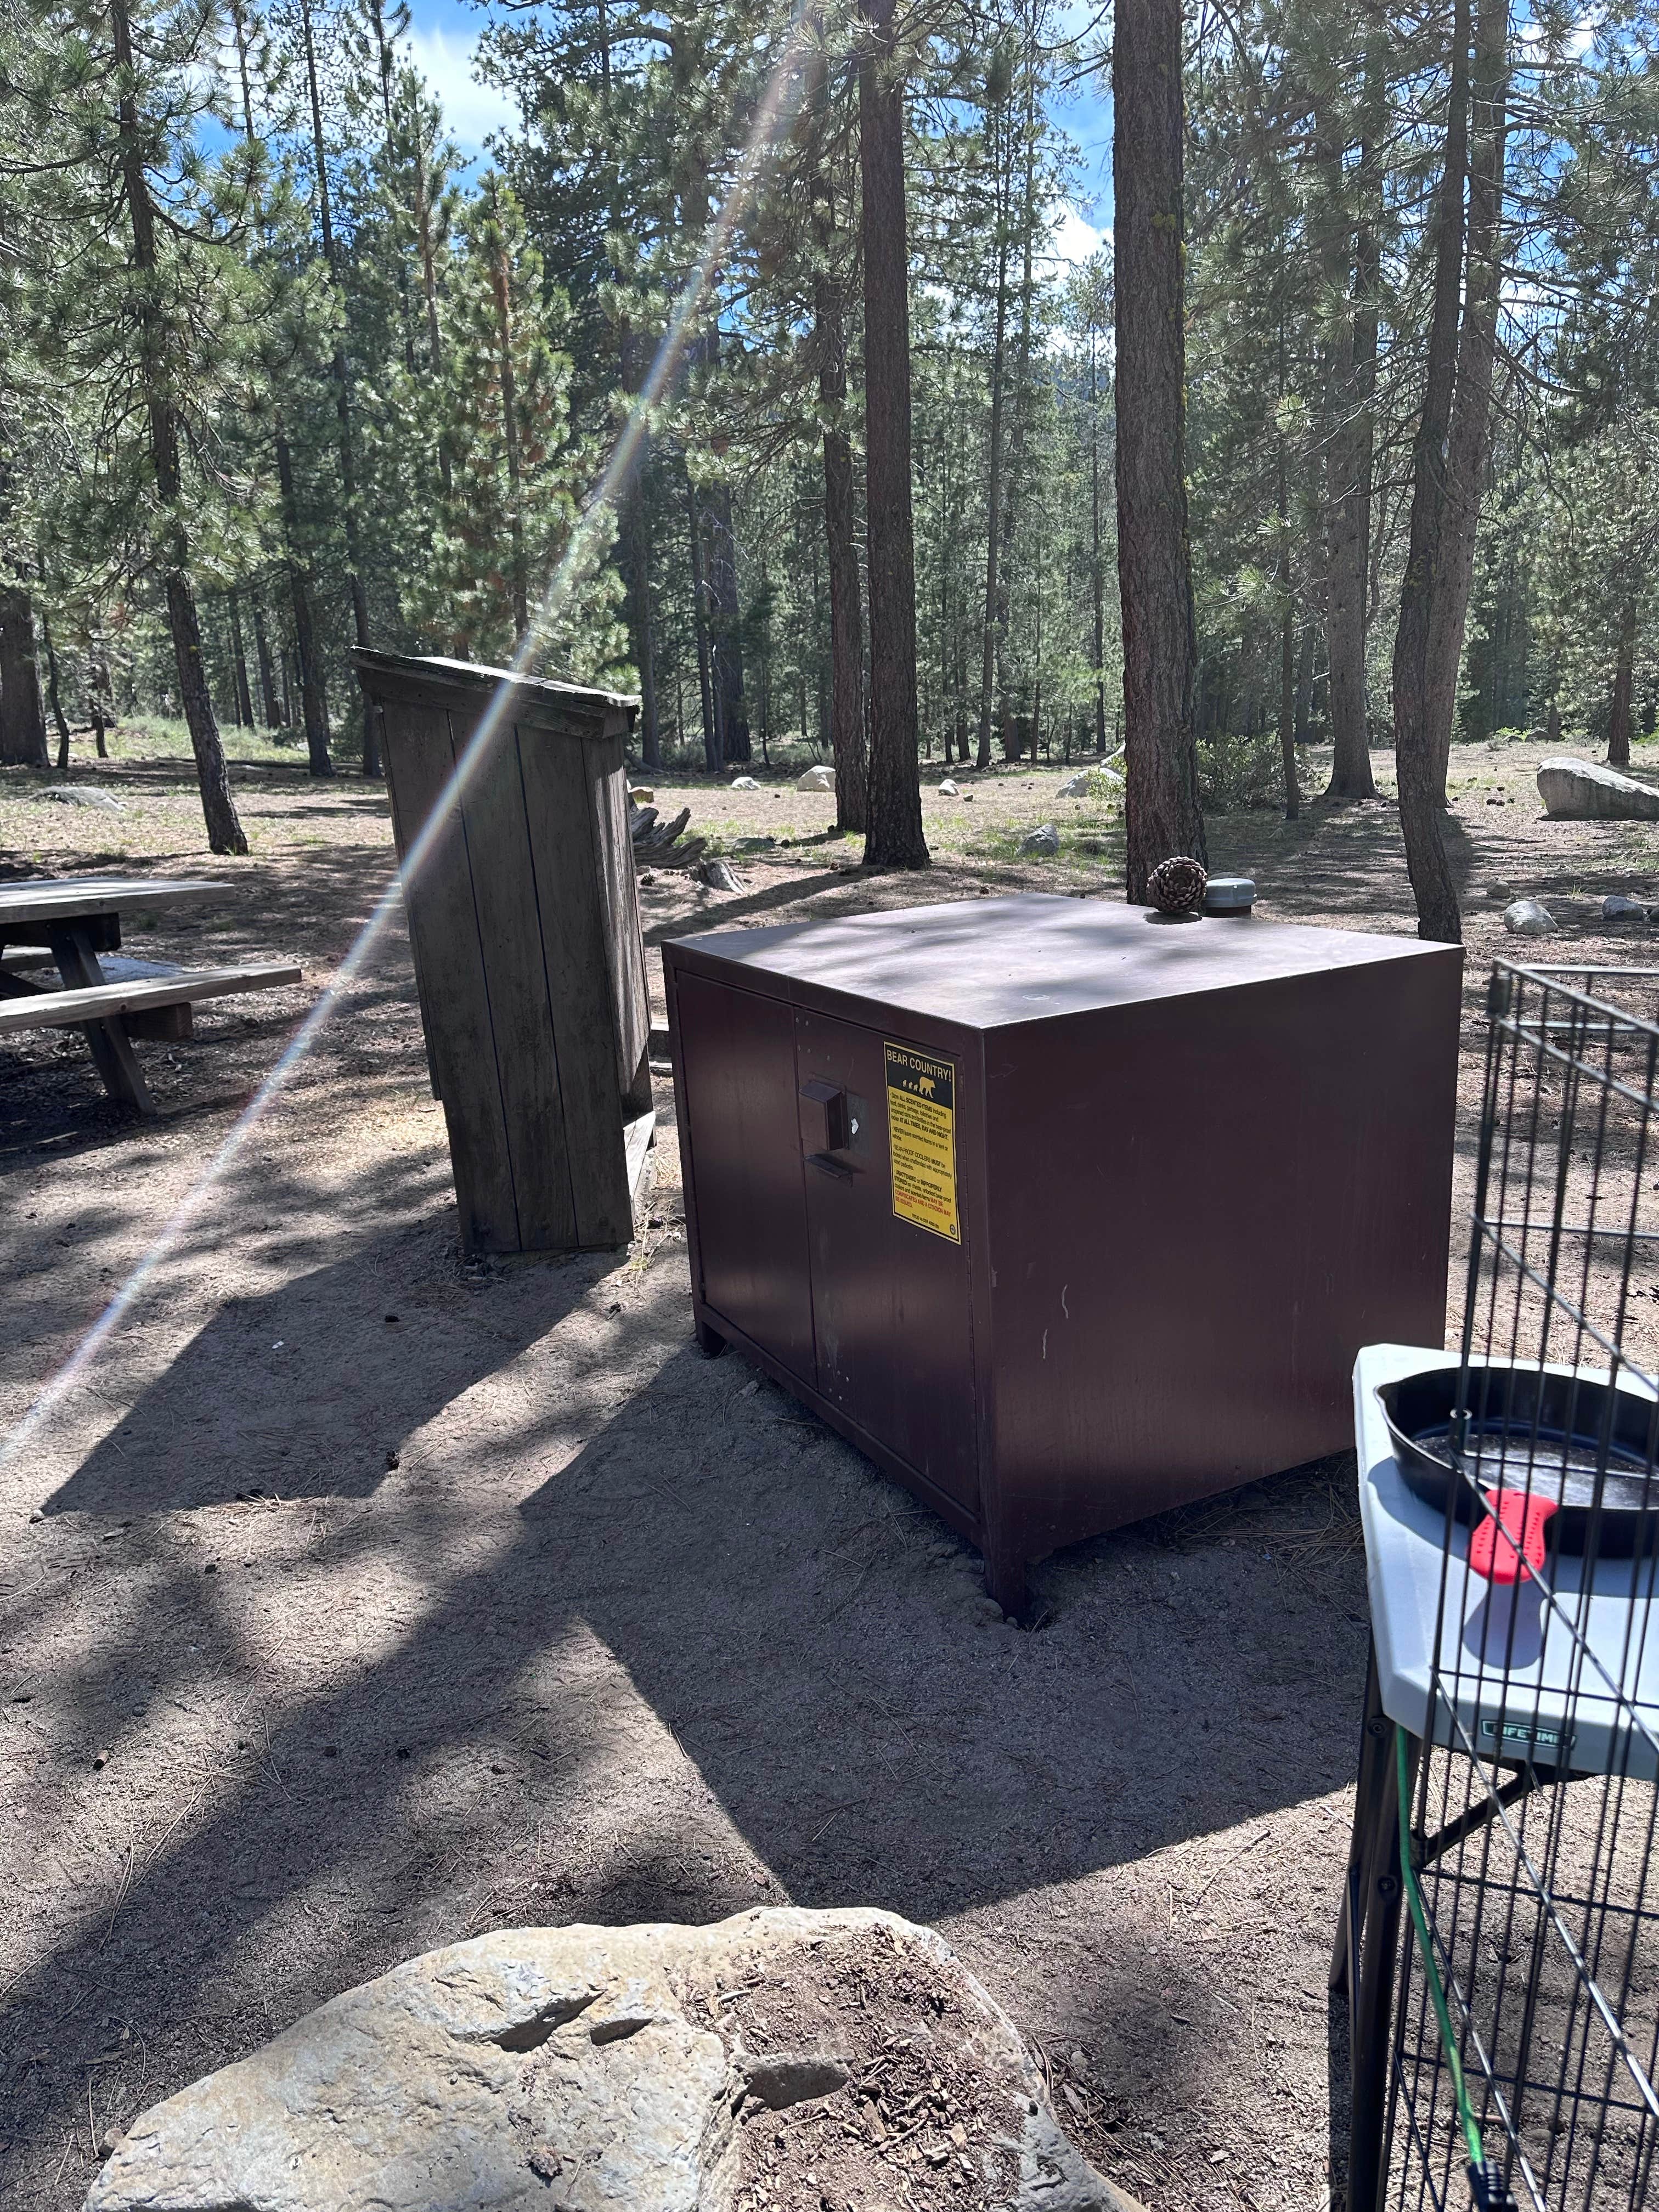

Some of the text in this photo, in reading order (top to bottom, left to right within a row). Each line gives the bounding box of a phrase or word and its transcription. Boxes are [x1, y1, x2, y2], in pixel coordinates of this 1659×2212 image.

[887, 1049, 951, 1082] BEAR COUNTRY!
[906, 1097, 922, 1108] SCENTED
[933, 1108, 946, 1119] including
[915, 1152, 930, 1163] COOLERS
[932, 1159, 941, 1167] MUST
[1493, 1724, 1563, 1744] IFEIM
